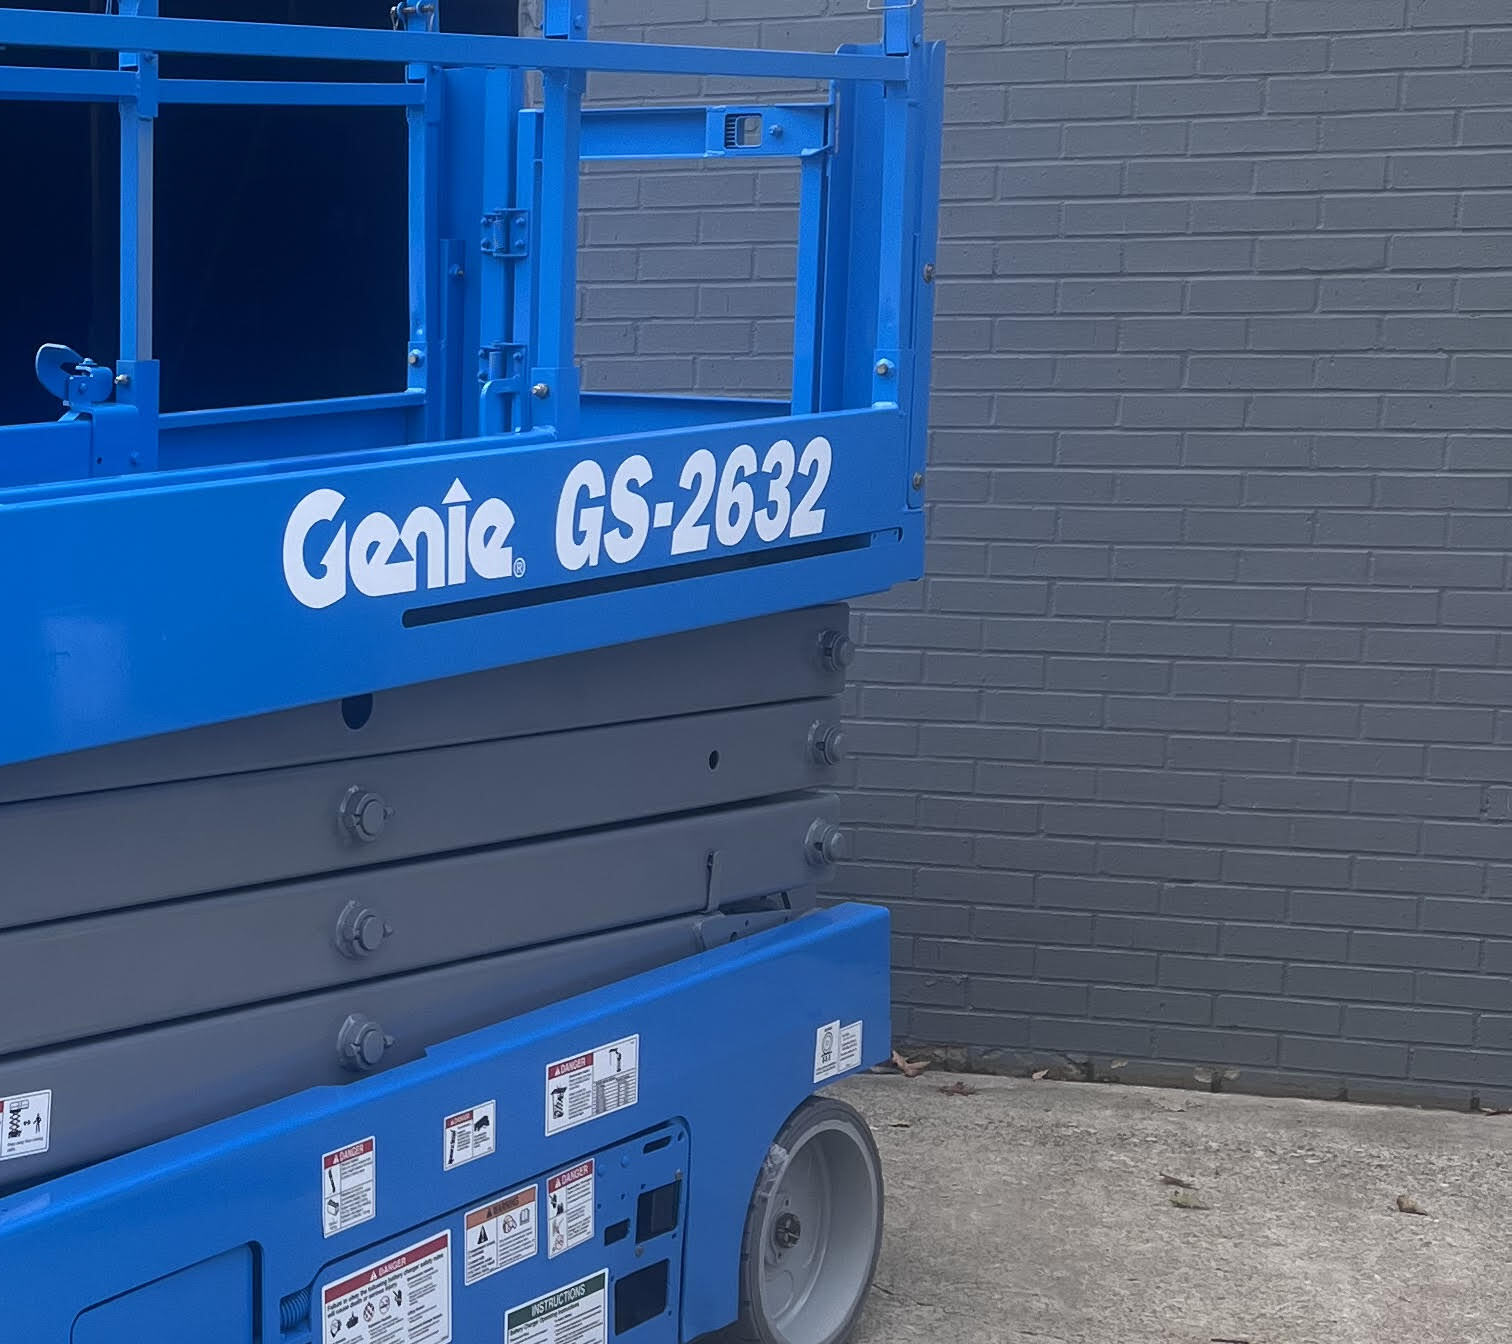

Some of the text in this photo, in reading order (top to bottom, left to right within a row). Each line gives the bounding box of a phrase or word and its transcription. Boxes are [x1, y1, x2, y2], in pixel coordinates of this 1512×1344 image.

[555, 436, 833, 571] GS-2632
[561, 1057, 586, 1073] DANGER
[339, 1144, 364, 1162] DANGER
[561, 1164, 588, 1185] DANGER
[379, 1257, 407, 1276] DANGER
[531, 1283, 586, 1317] INSTRUCTIONS
